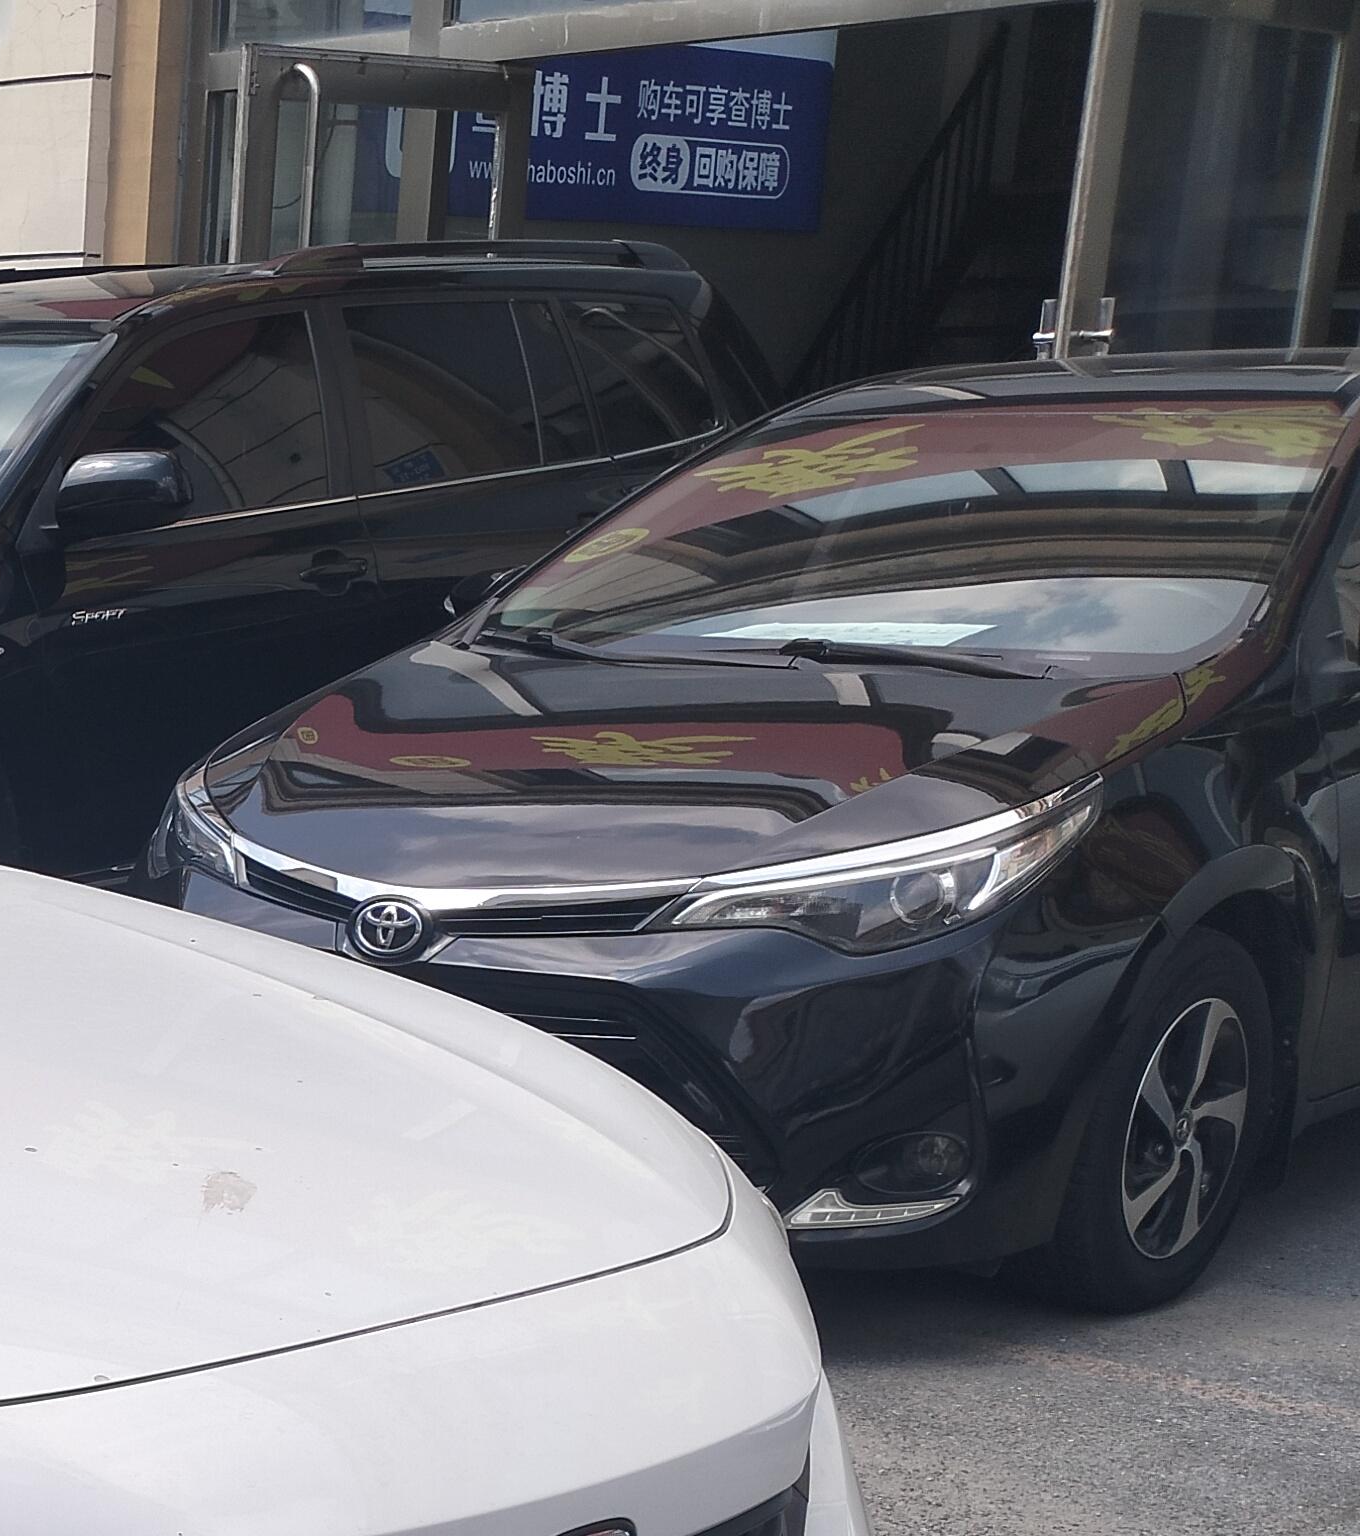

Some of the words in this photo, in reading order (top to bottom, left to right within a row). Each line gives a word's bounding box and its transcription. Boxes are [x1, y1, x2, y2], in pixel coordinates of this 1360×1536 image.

[637, 78, 793, 131] 购车可享查博士
[469, 157, 616, 187] wwhaboshi.cn
[637, 142, 684, 185] 终身
[693, 146, 780, 192] 回购保障
